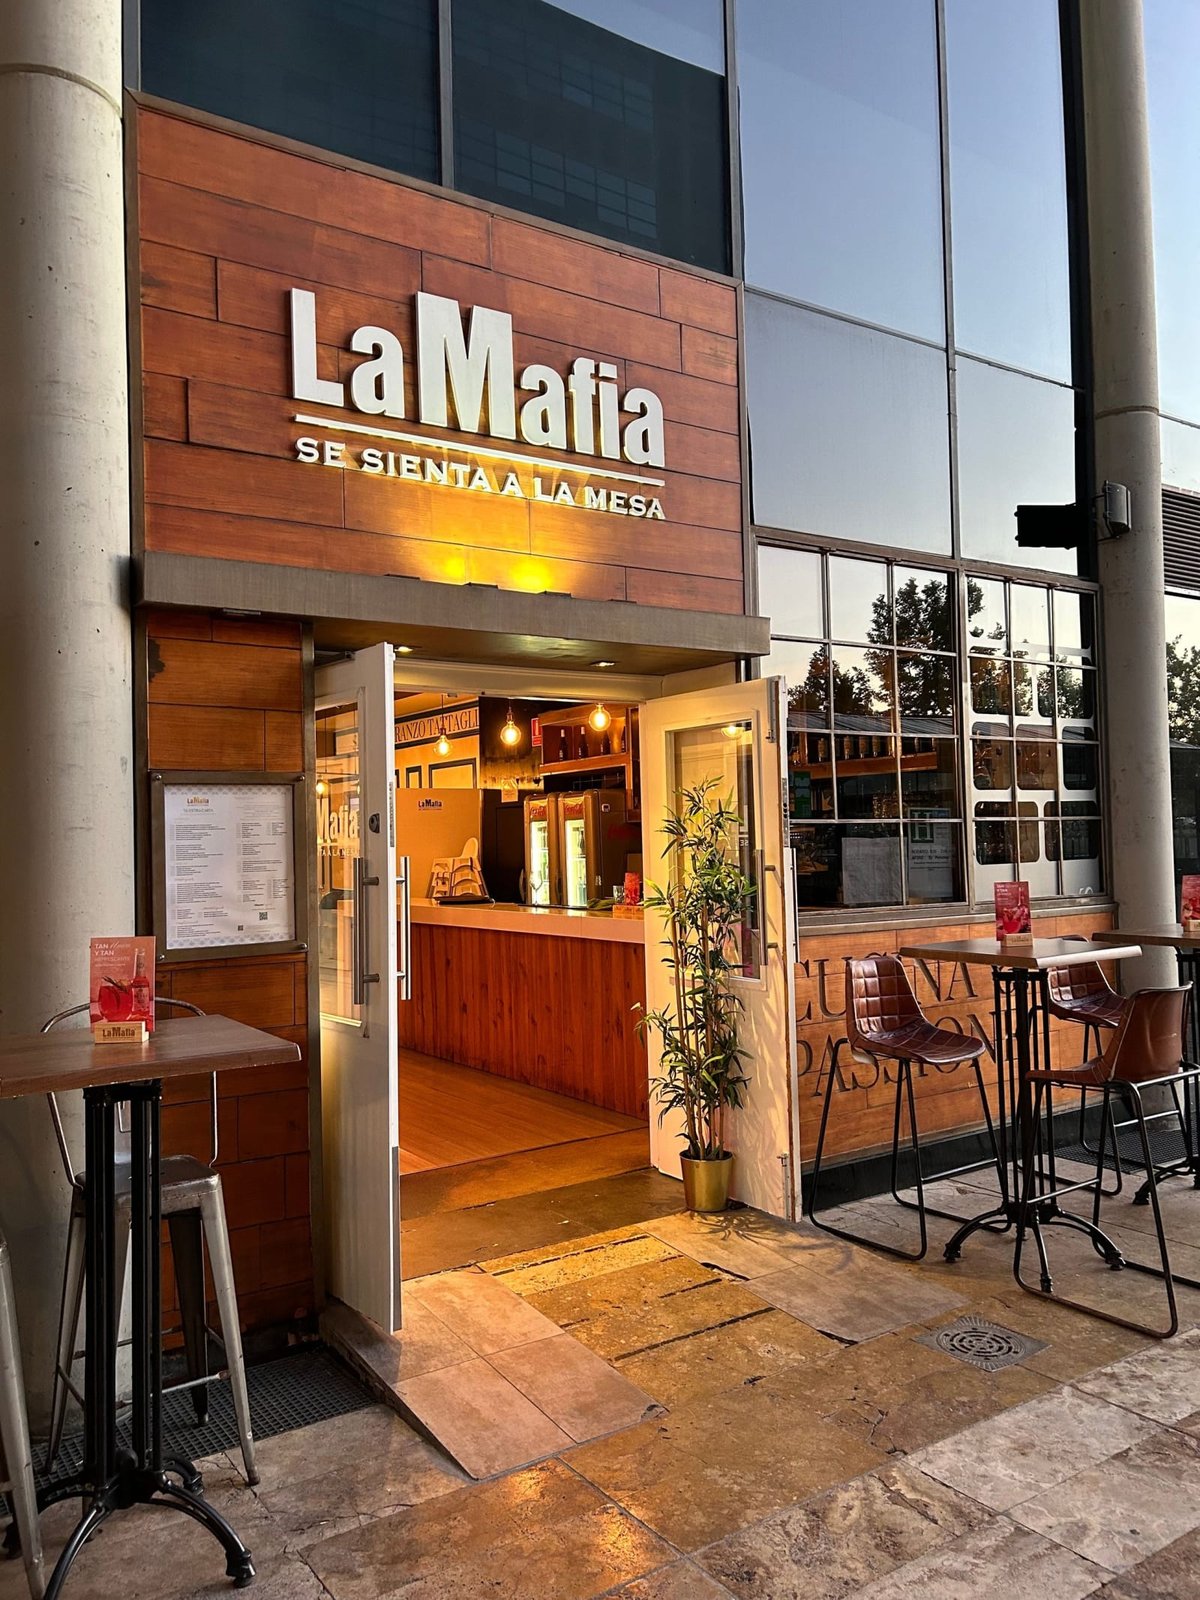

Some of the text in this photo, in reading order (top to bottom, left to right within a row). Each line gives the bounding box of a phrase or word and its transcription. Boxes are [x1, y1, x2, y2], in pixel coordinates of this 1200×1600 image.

[290, 287, 665, 468] LaMafia
[295, 436, 666, 520] SE SIENTA A LA MESA
[418, 799, 442, 808] LaMafia
